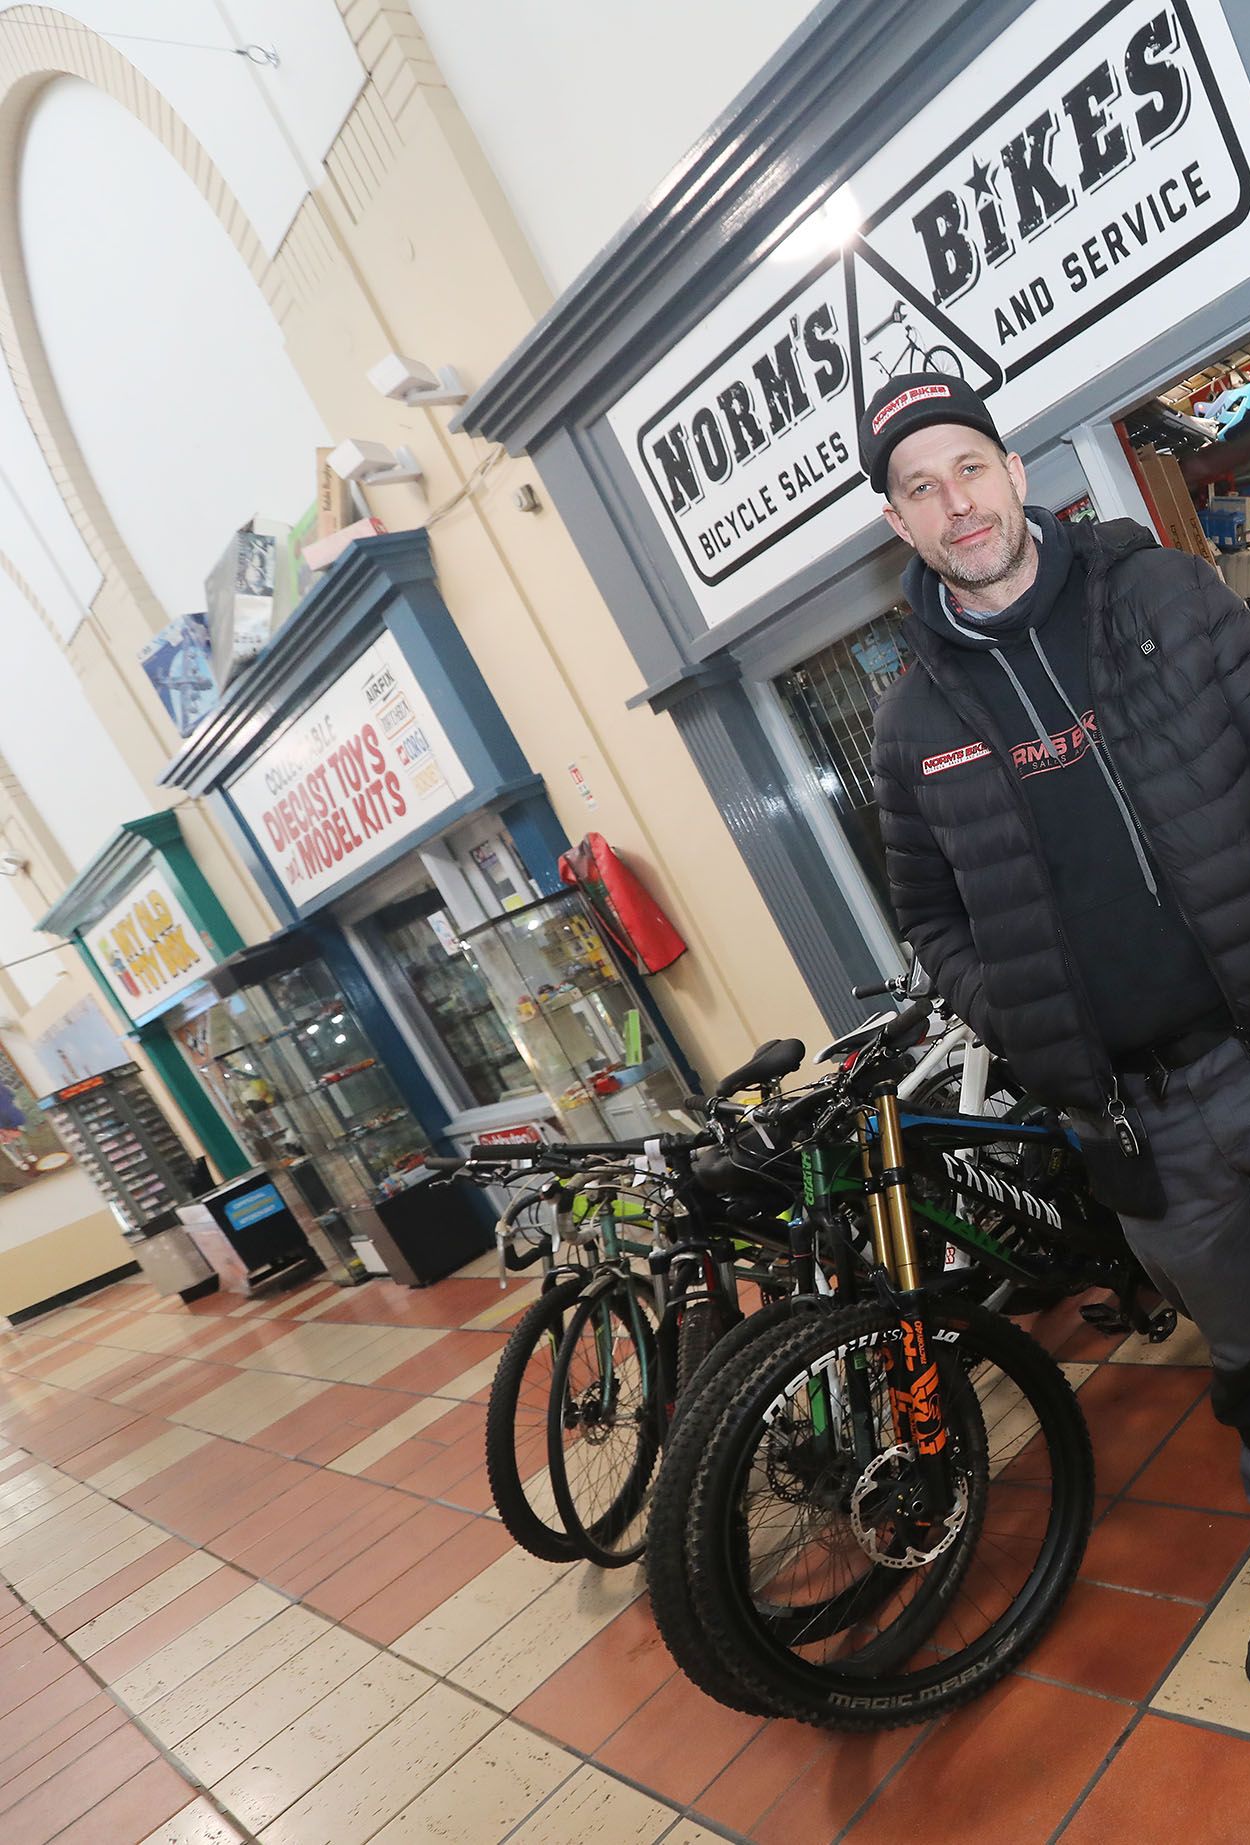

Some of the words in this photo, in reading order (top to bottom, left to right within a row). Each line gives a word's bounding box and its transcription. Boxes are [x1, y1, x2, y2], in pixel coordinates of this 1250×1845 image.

[994, 276, 1055, 346] AND
[1062, 160, 1211, 293] SERVICE
[653, 303, 850, 514] NORM'S
[698, 485, 778, 561] BICYCLE
[779, 432, 849, 502] SALES
[365, 669, 396, 704] AIRFIX
[262, 764, 337, 853] DIECAST
[328, 724, 386, 799] TOYS
[403, 727, 430, 761] CORGI
[297, 807, 363, 880] MODEL
[352, 771, 407, 840] KITS
[942, 1151, 1063, 1230] CANYON
[932, 1328, 960, 1345] DT
[827, 1691, 913, 1711] MAGIC
[919, 1655, 994, 1700] MARY
